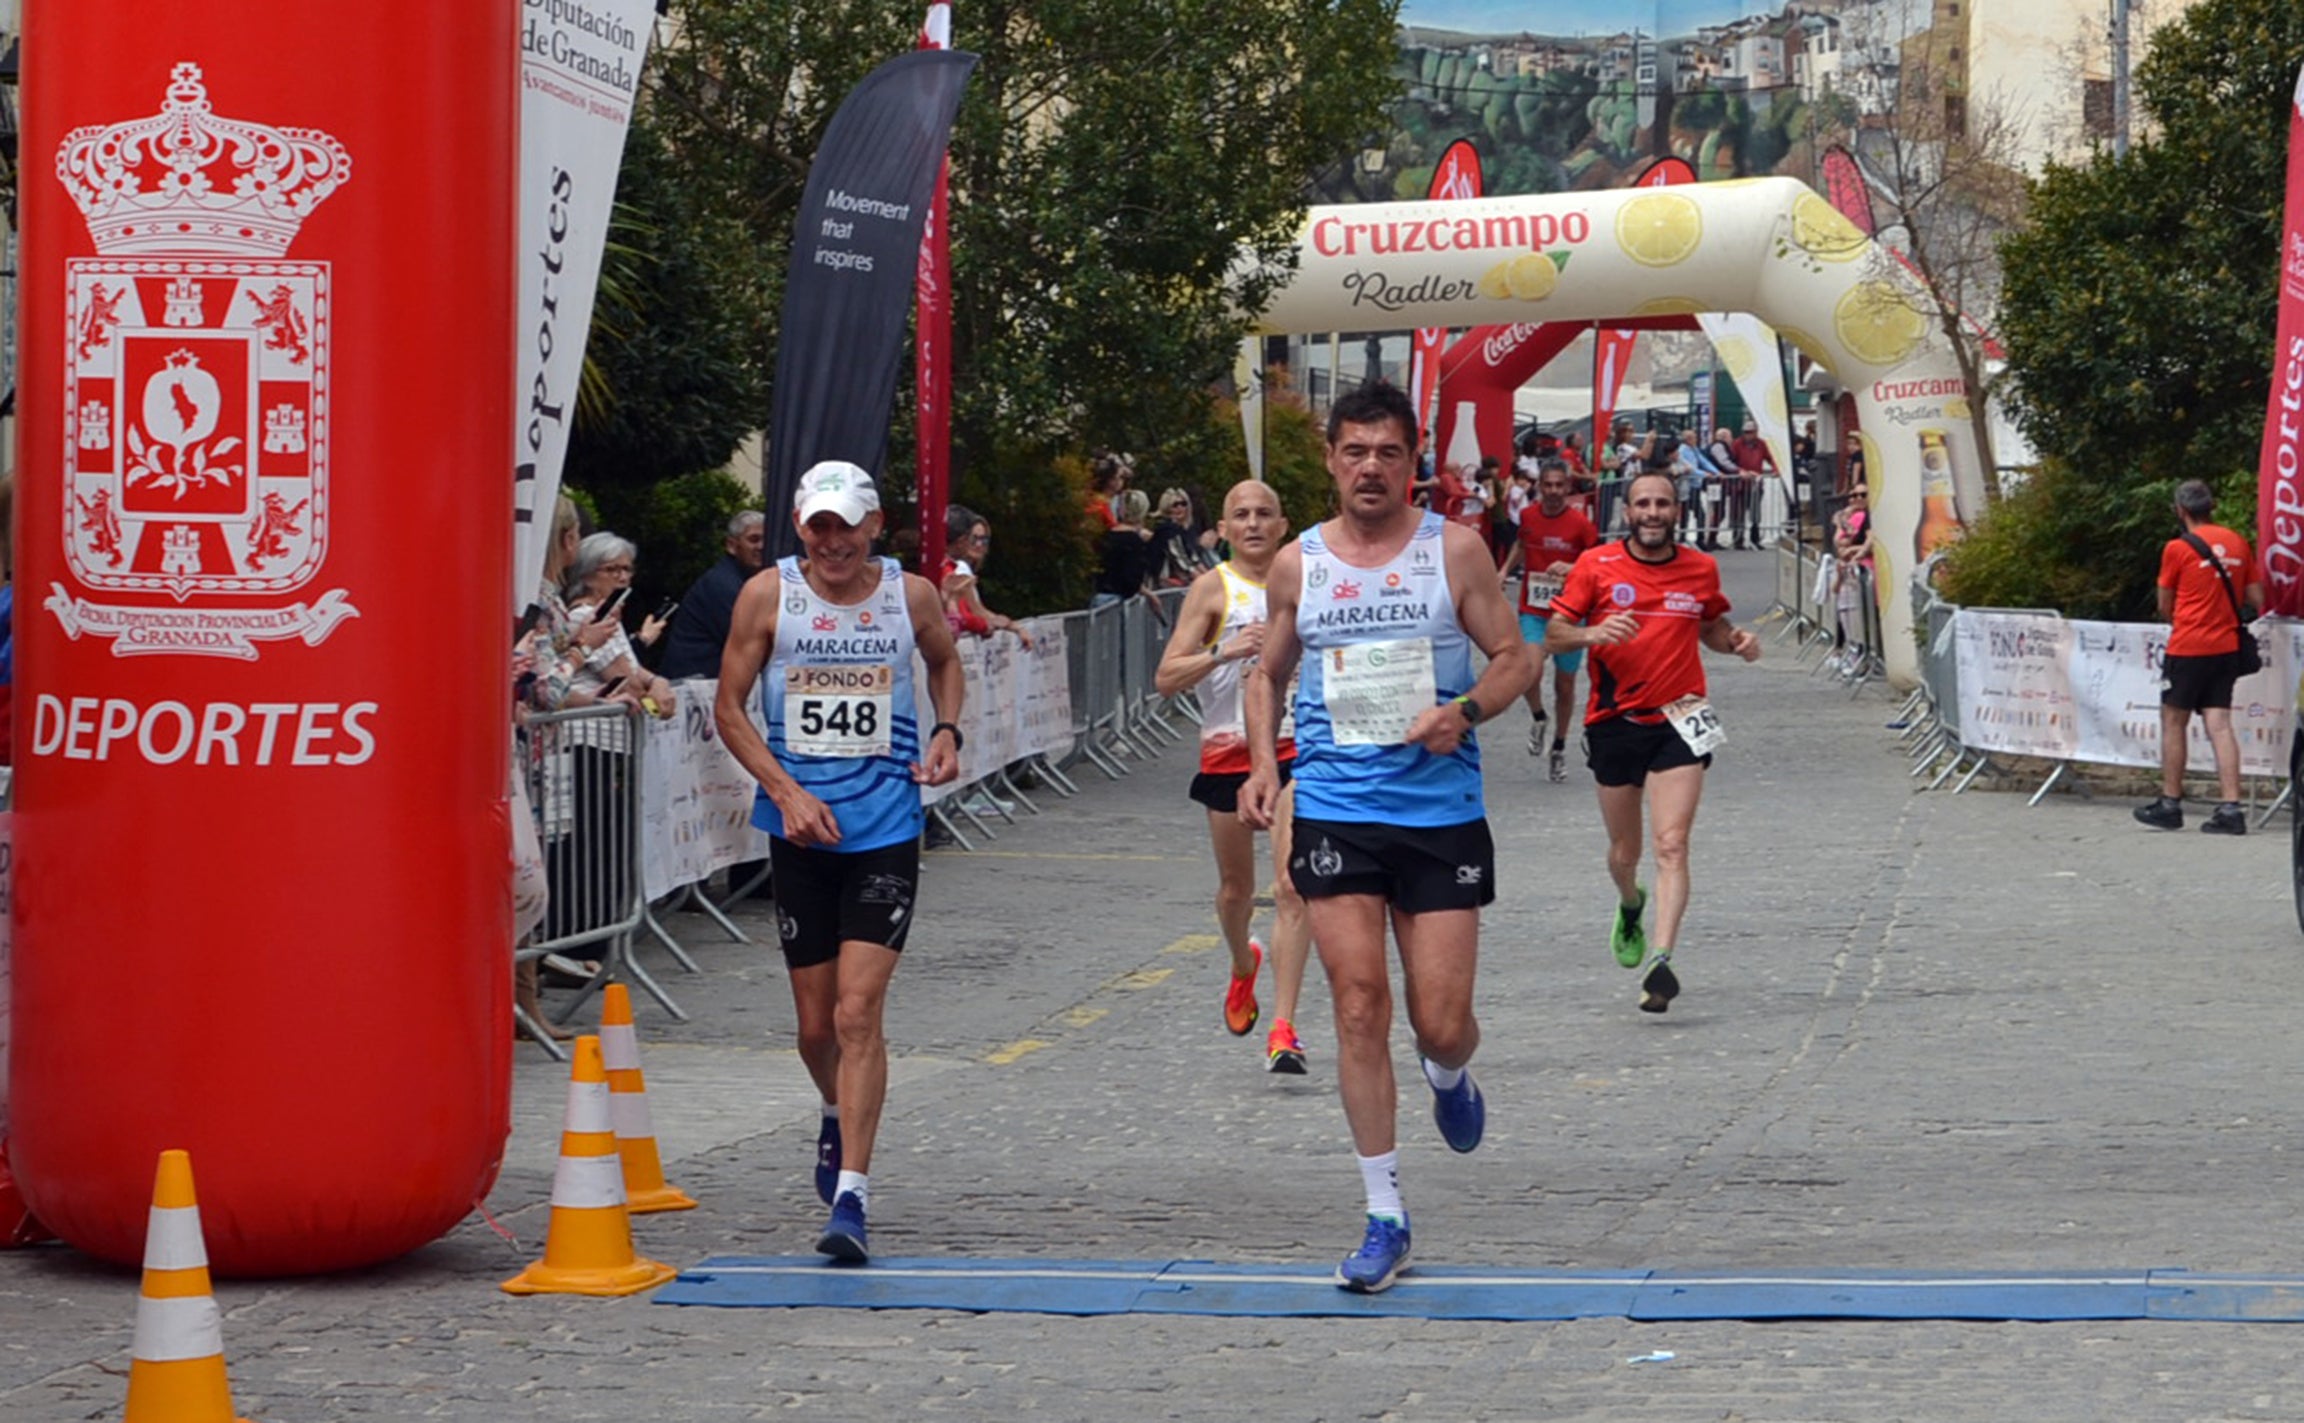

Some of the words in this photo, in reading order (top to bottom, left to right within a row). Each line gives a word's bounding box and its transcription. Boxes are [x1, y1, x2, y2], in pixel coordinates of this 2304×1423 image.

[524, 0, 635, 51] iputación
[522, 19, 549, 56] de
[551, 30, 633, 93] Granada
[825, 189, 910, 221] Movement
[821, 218, 854, 239] that
[1313, 211, 1590, 257] Cruzcampo
[814, 245, 874, 272] inspires
[1343, 269, 1478, 312] Radler
[1873, 378, 1969, 402] Cruzcam
[1317, 603, 1429, 628] MARACENA
[127, 626, 234, 646] GRANADA
[794, 638, 898, 655] MARACENA
[807, 671, 874, 687] FONDO
[32, 693, 378, 766] DEPORTES
[801, 700, 877, 737] 548
